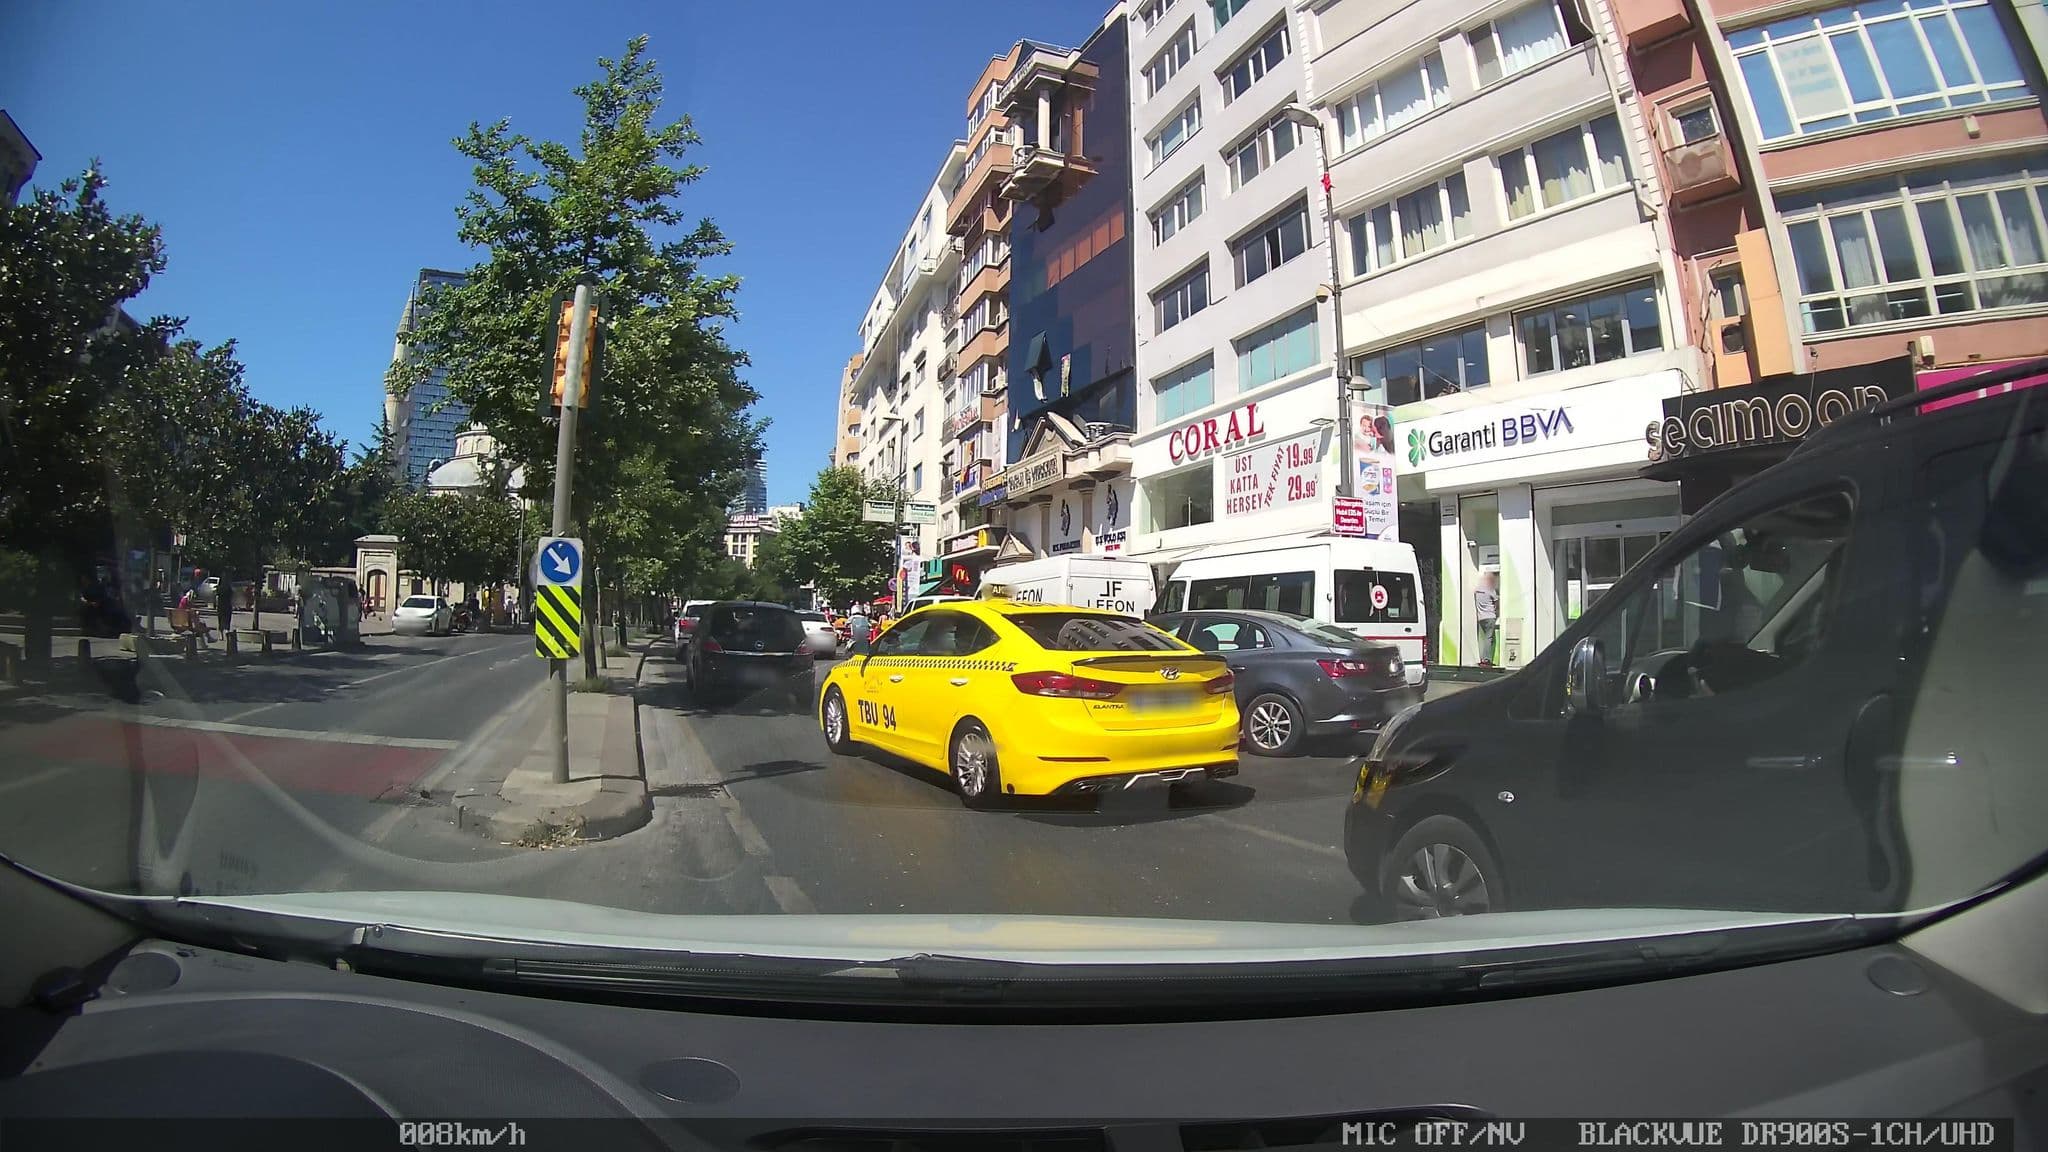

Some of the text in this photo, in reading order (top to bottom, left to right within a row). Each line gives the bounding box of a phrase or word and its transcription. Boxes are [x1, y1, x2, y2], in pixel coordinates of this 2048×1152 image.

[1169, 402, 1265, 461] CORAL
[1429, 406, 1574, 455] Garanti BBVA
[1235, 455, 1253, 474] ÜST
[1286, 442, 1313, 470] 19.99
[1230, 473, 1259, 495] KATTA
[1264, 445, 1286, 508] TEK FİYAT
[1287, 475, 1316, 502] 29.99
[1226, 492, 1263, 514] HERŞEY
[858, 699, 897, 731] TBU 94
